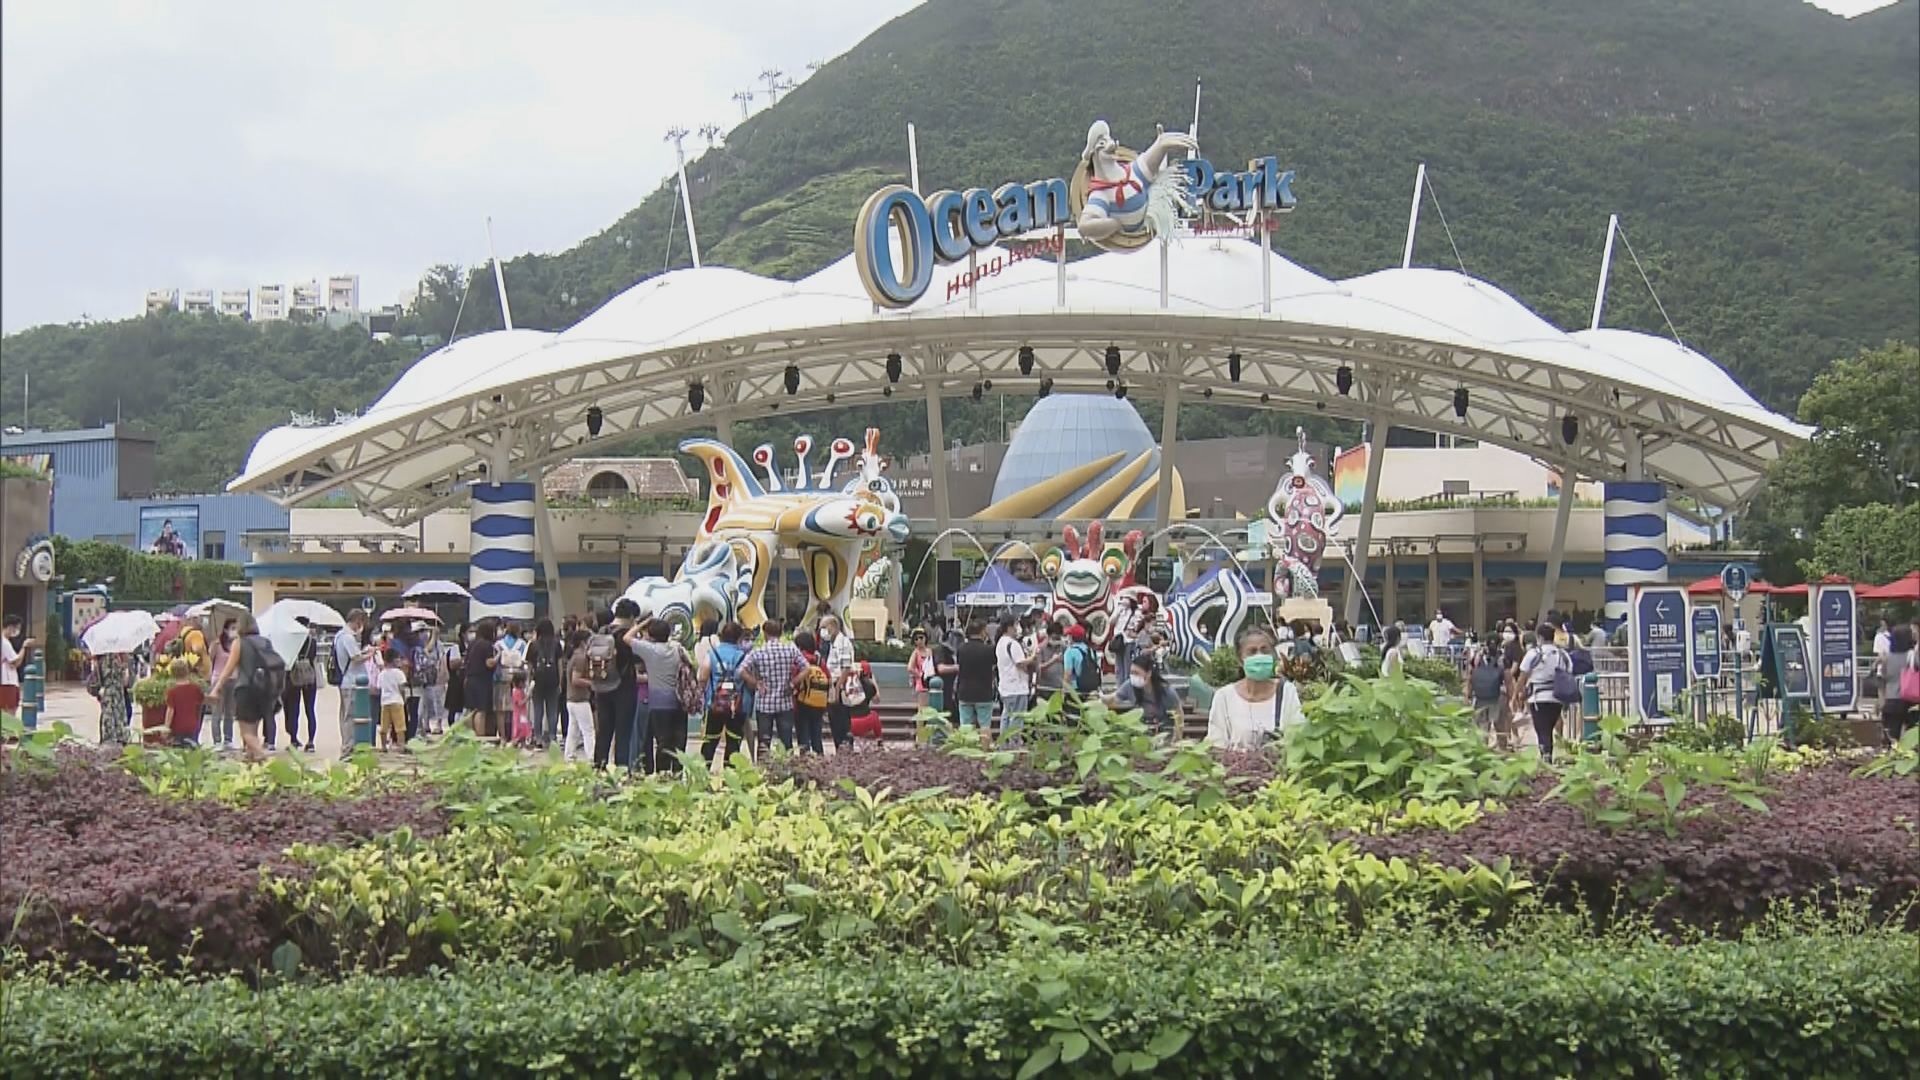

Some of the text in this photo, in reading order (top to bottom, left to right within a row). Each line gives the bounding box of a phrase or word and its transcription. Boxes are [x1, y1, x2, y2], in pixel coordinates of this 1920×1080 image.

[855, 156, 1297, 309] Ocean Park
[946, 256, 1002, 304] Hong
